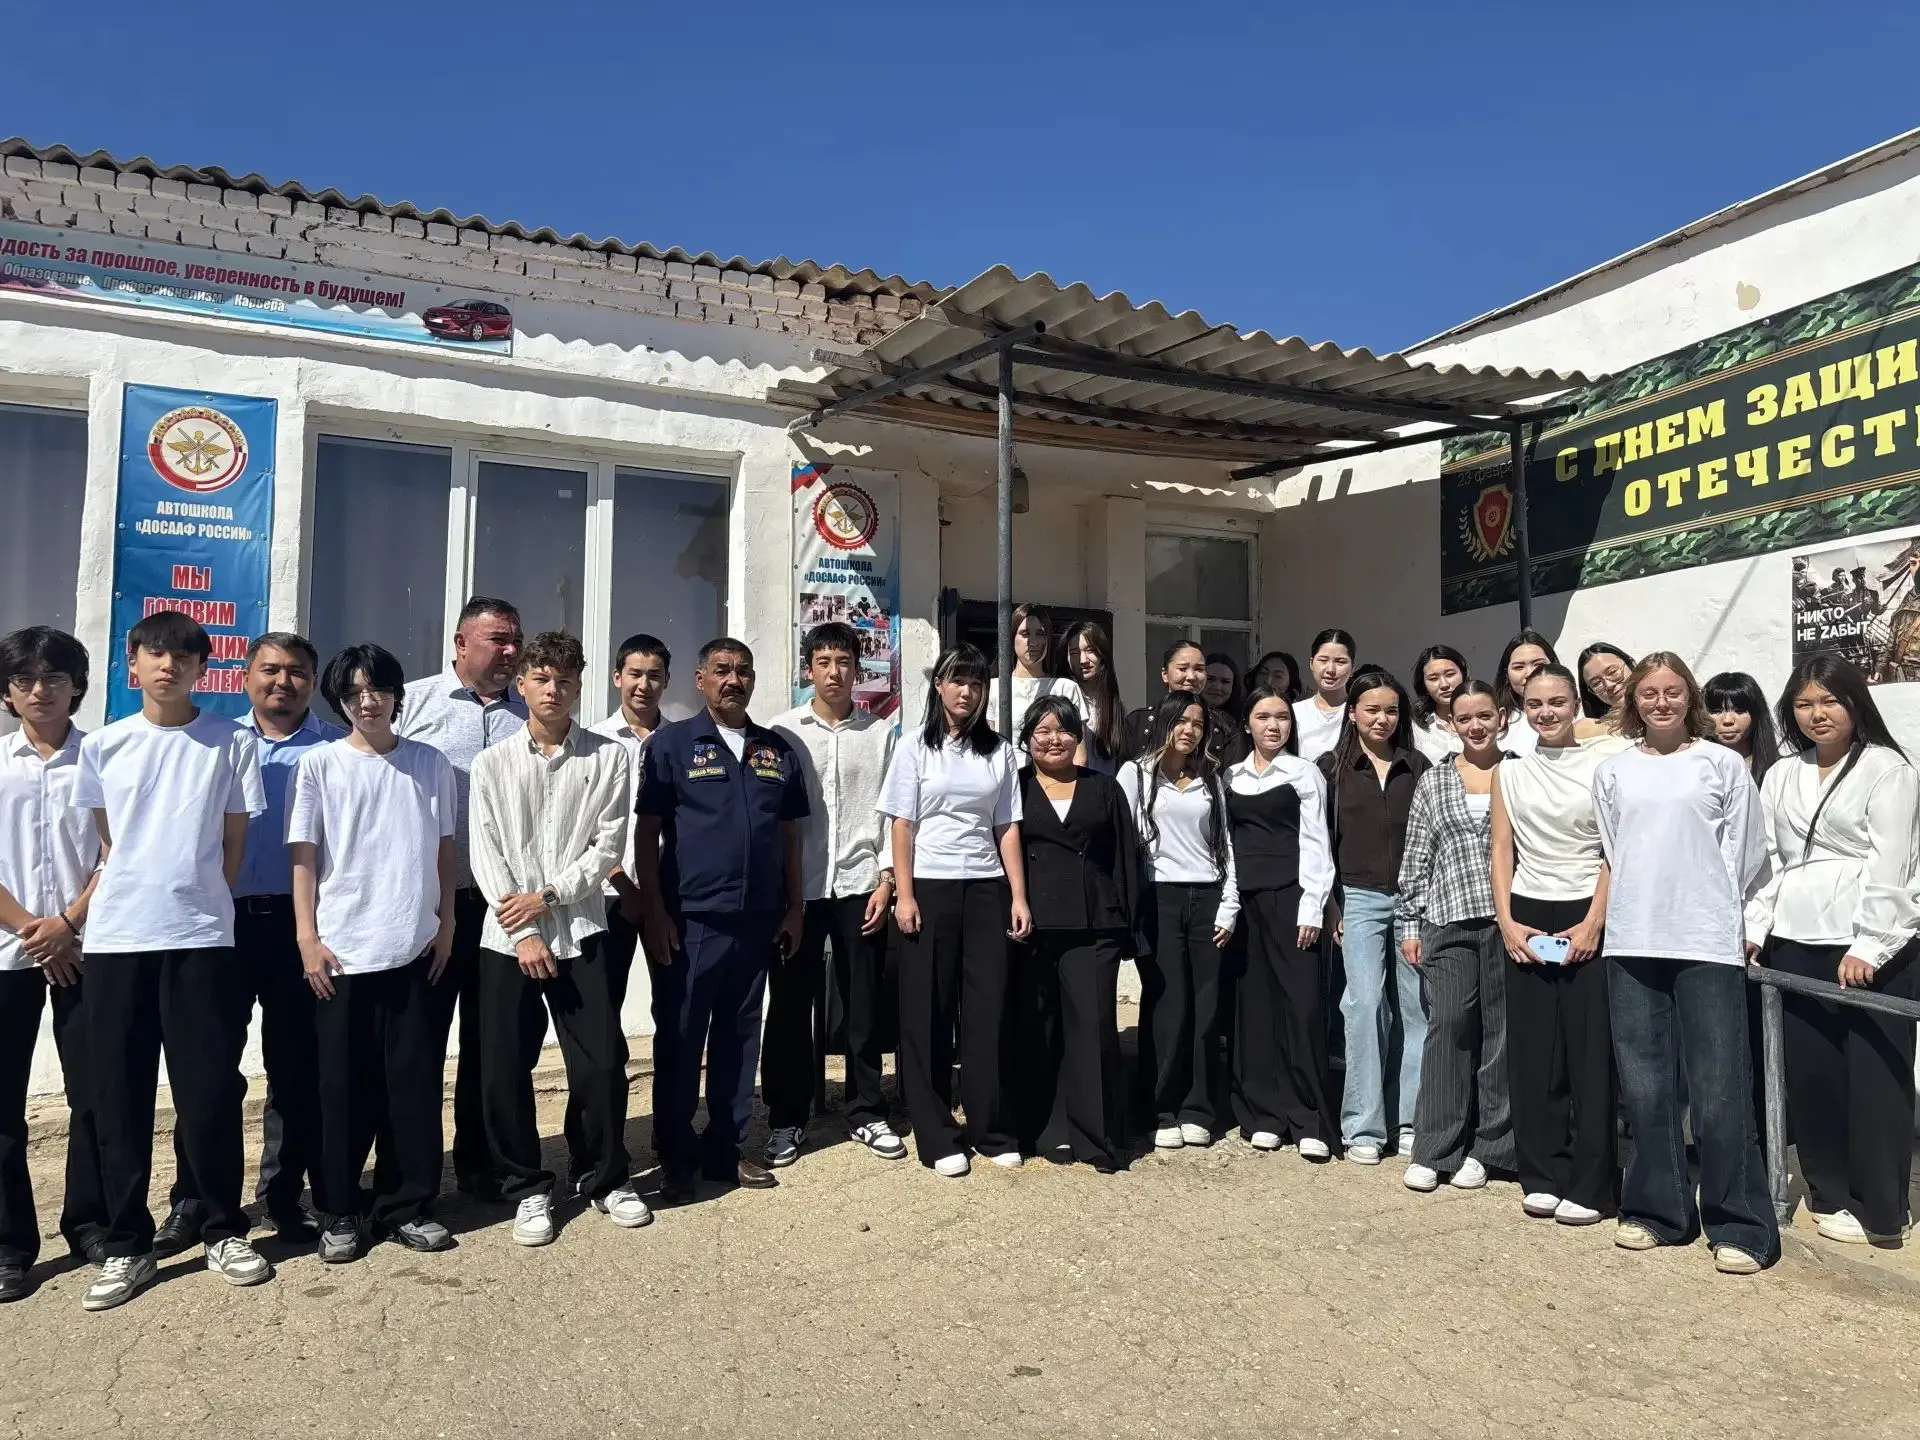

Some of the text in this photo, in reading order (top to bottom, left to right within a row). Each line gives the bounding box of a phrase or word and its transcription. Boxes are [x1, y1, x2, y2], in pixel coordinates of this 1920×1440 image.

[0, 238, 405, 308] дость за прошлое, уверенность в будущем!
[3, 262, 94, 286] Образование.
[234, 293, 287, 312] Карьера.
[1555, 338, 1918, 482] С ДНЕМ ЗАЩИ
[1457, 454, 1532, 488] 23 феврая
[1623, 404, 1920, 517] ОТЕЧЕСТ
[156, 500, 233, 520] АВТОШКОЛА
[135, 519, 252, 540] «ДОСААФ РОССИИ»
[818, 557, 873, 573] АВТОШКОЛА
[172, 564, 211, 591] МЫ
[805, 571, 847, 584] «ДОСААФ
[1796, 606, 1845, 625] НИКТО
[1796, 627, 1816, 642] НЕ
